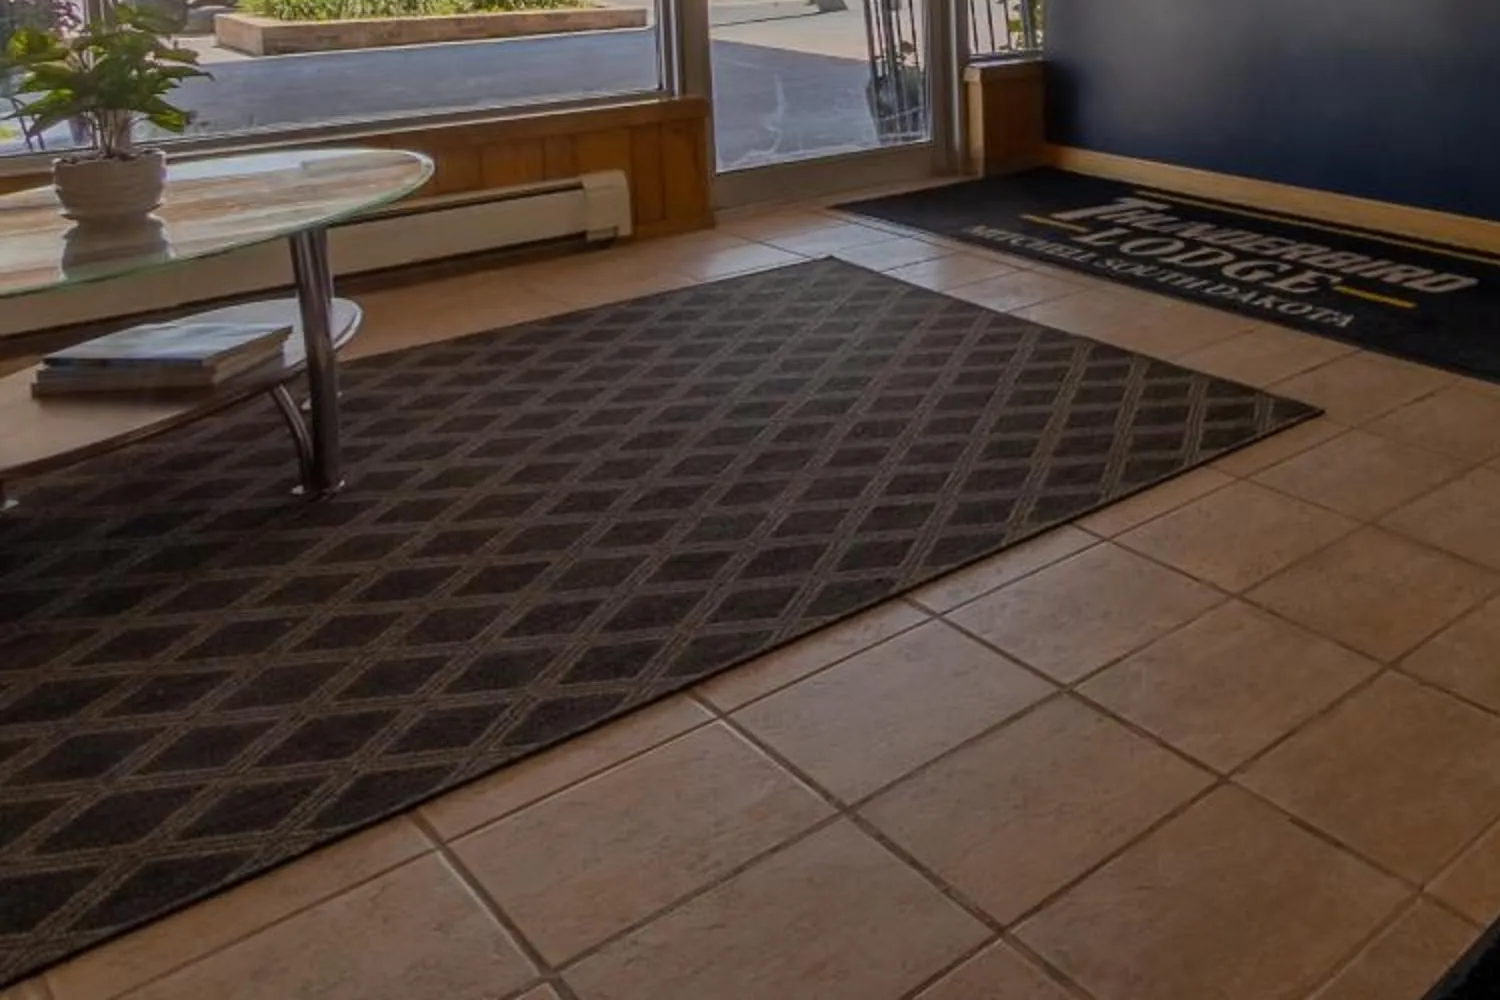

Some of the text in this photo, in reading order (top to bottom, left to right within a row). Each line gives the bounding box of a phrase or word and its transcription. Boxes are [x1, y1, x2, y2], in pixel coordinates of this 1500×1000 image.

[967, 225, 1355, 328] MITCHELL SOUTH DAKOTA
[1049, 196, 1480, 293] THUNDERBIRD
[1071, 227, 1343, 293] LODGE
